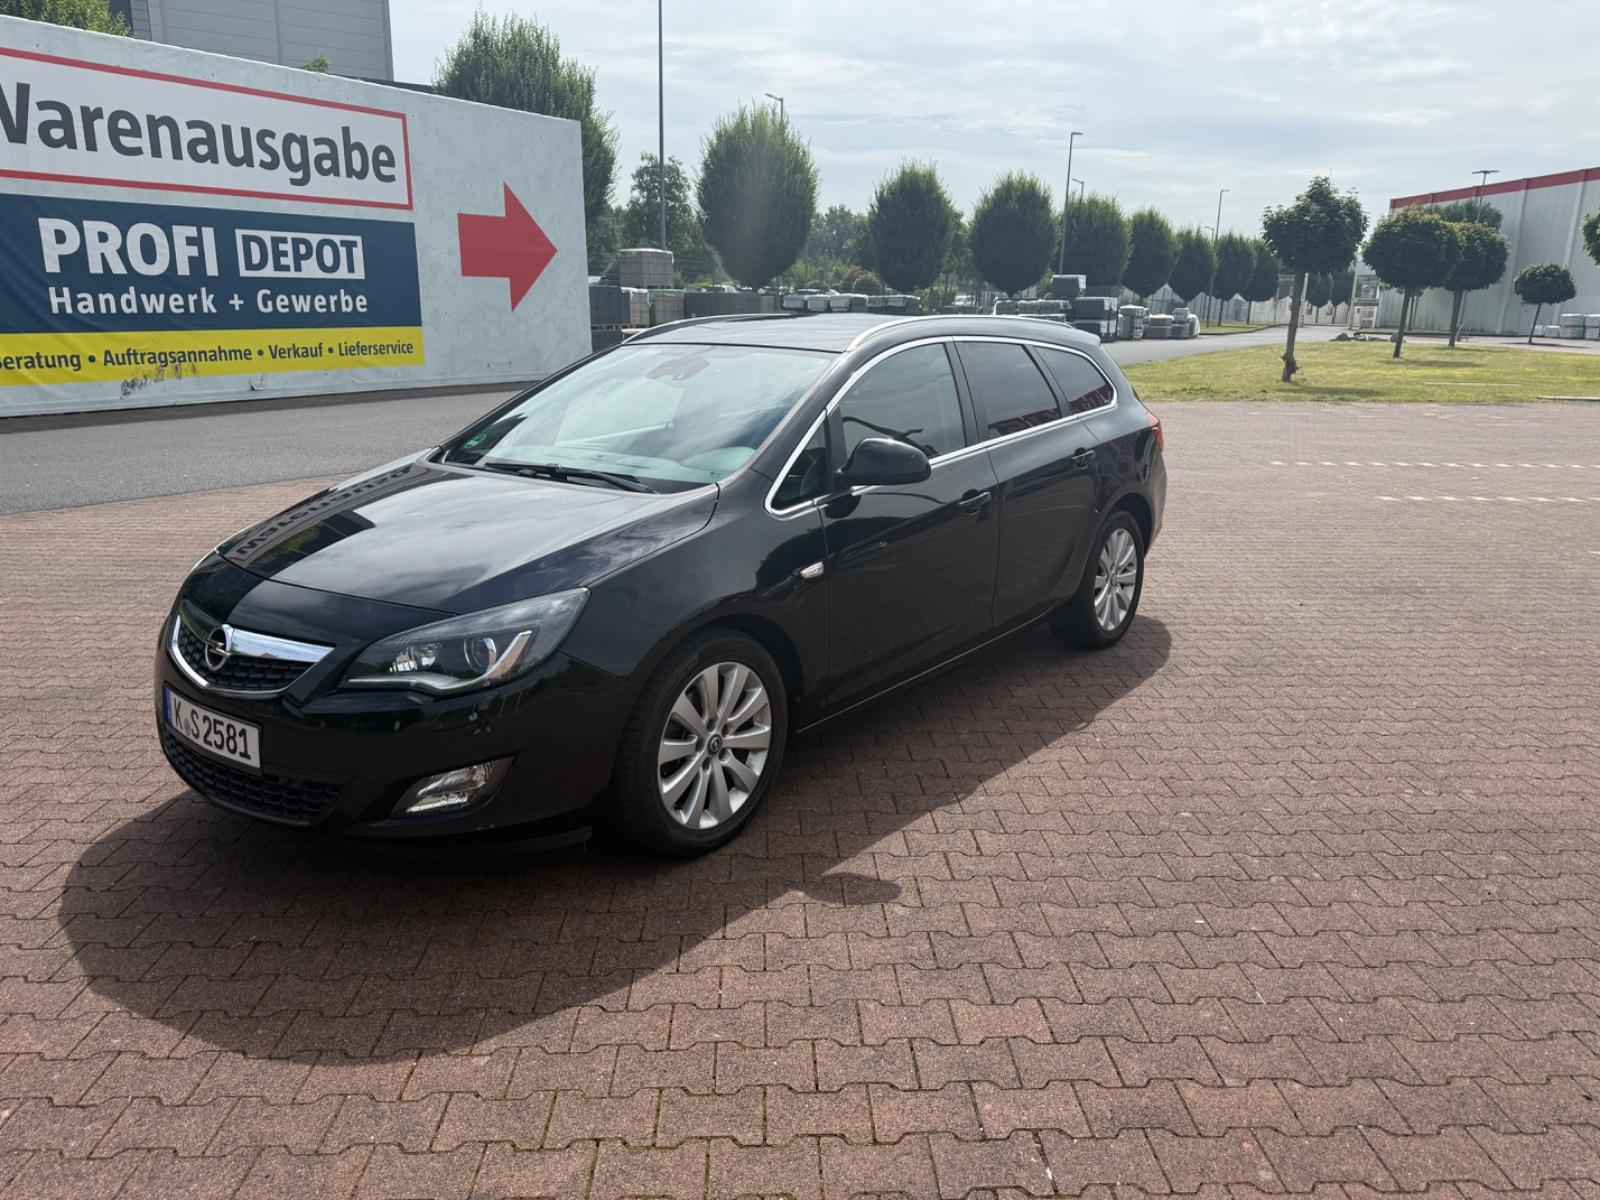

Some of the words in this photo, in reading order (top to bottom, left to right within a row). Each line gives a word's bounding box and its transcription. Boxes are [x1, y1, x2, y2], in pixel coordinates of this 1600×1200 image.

[38, 217, 219, 277] PROFI
[241, 233, 358, 274] DEPOT
[48, 285, 218, 314] Handwerk
[256, 288, 368, 313] Gewerbe
[0, 351, 82, 372] eratung
[103, 346, 252, 368] Auftragsannahme
[268, 342, 324, 360] Verkauf
[338, 339, 414, 357] Lieferservice
